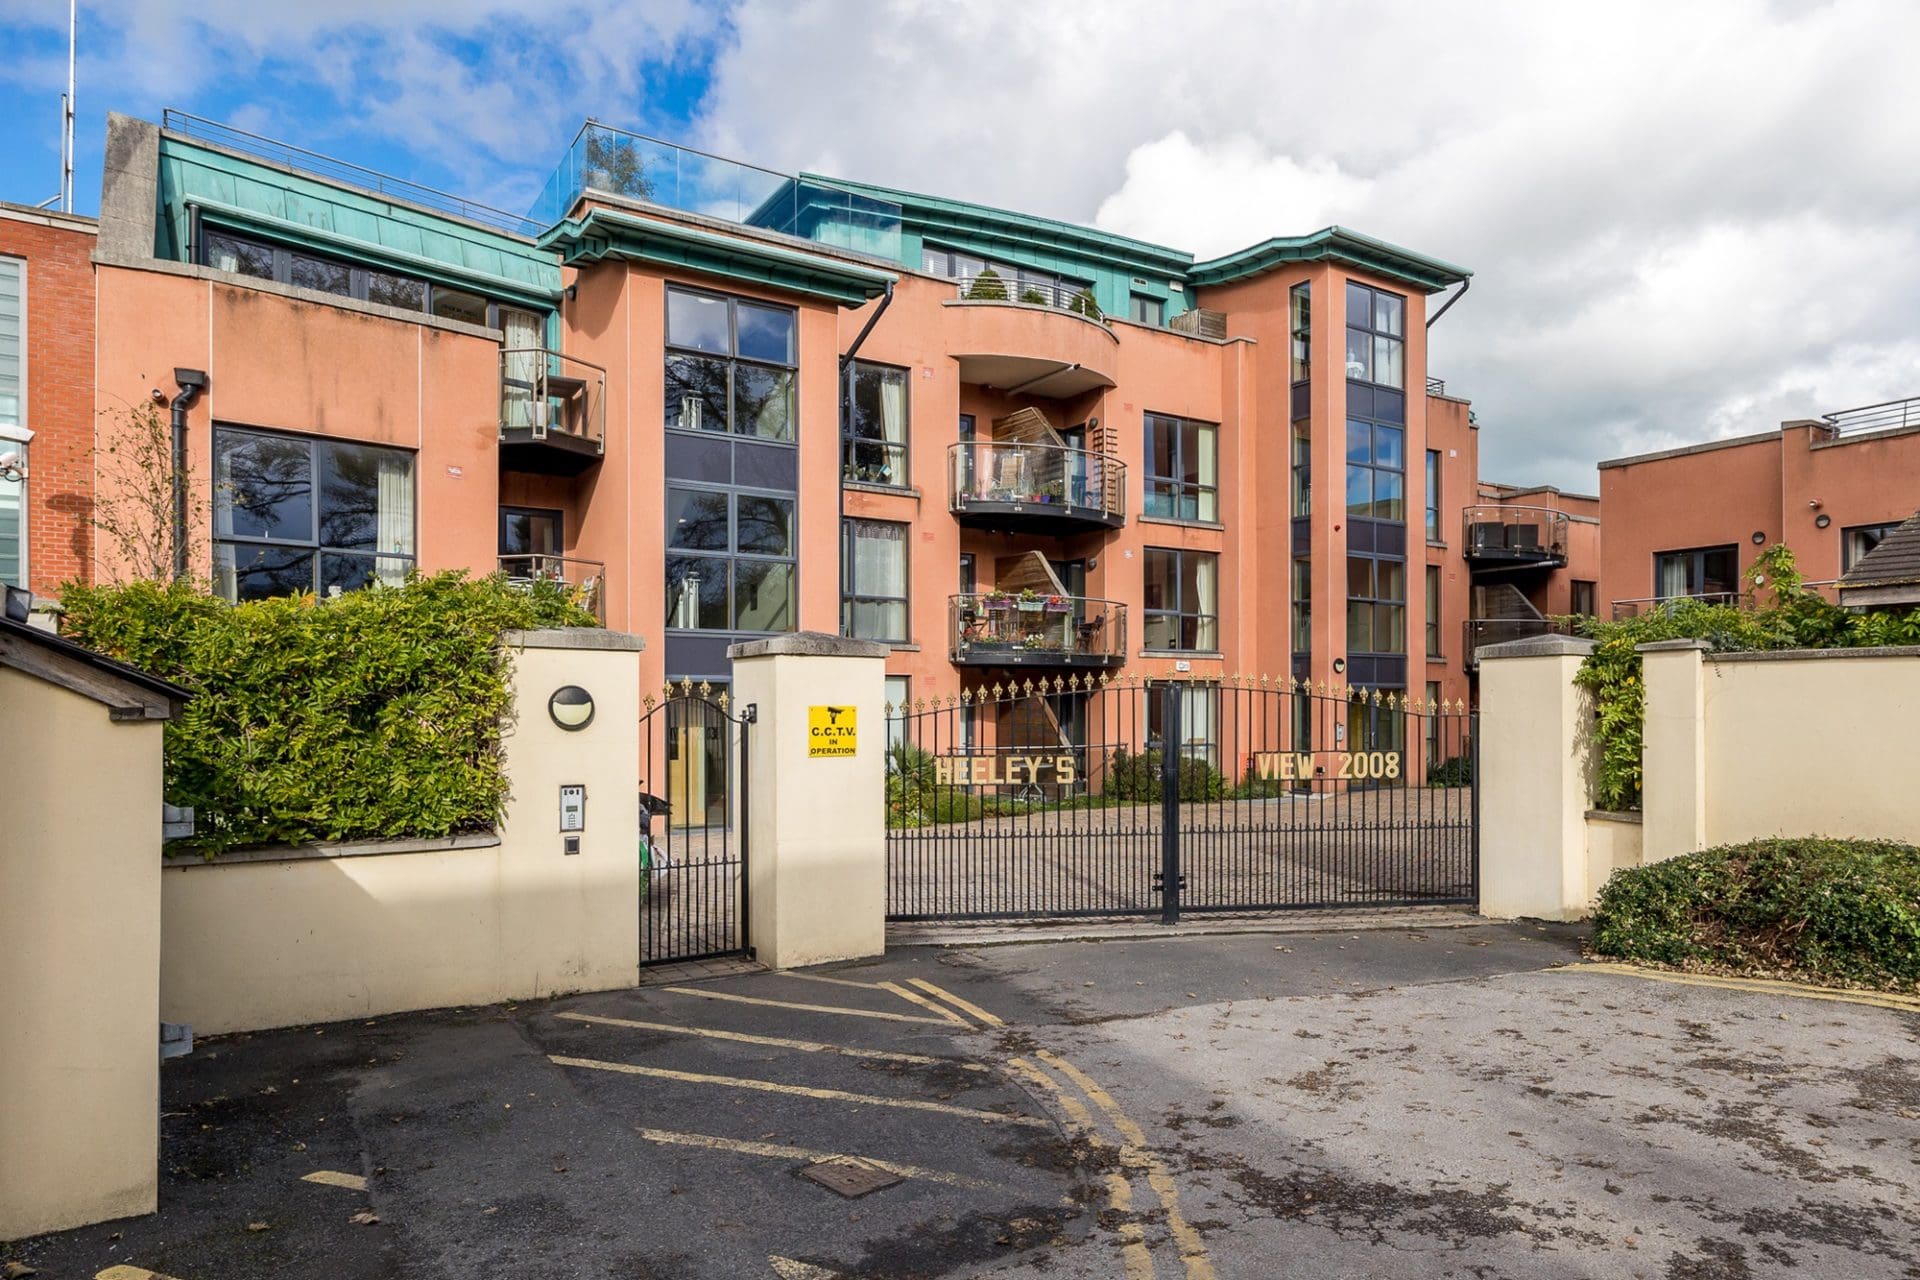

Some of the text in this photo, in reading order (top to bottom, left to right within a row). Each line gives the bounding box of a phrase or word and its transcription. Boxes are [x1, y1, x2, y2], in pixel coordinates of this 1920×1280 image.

[811, 727, 856, 736] C.C.T.V.
[935, 751, 1400, 785] HEELEY'S VIEW 2008
